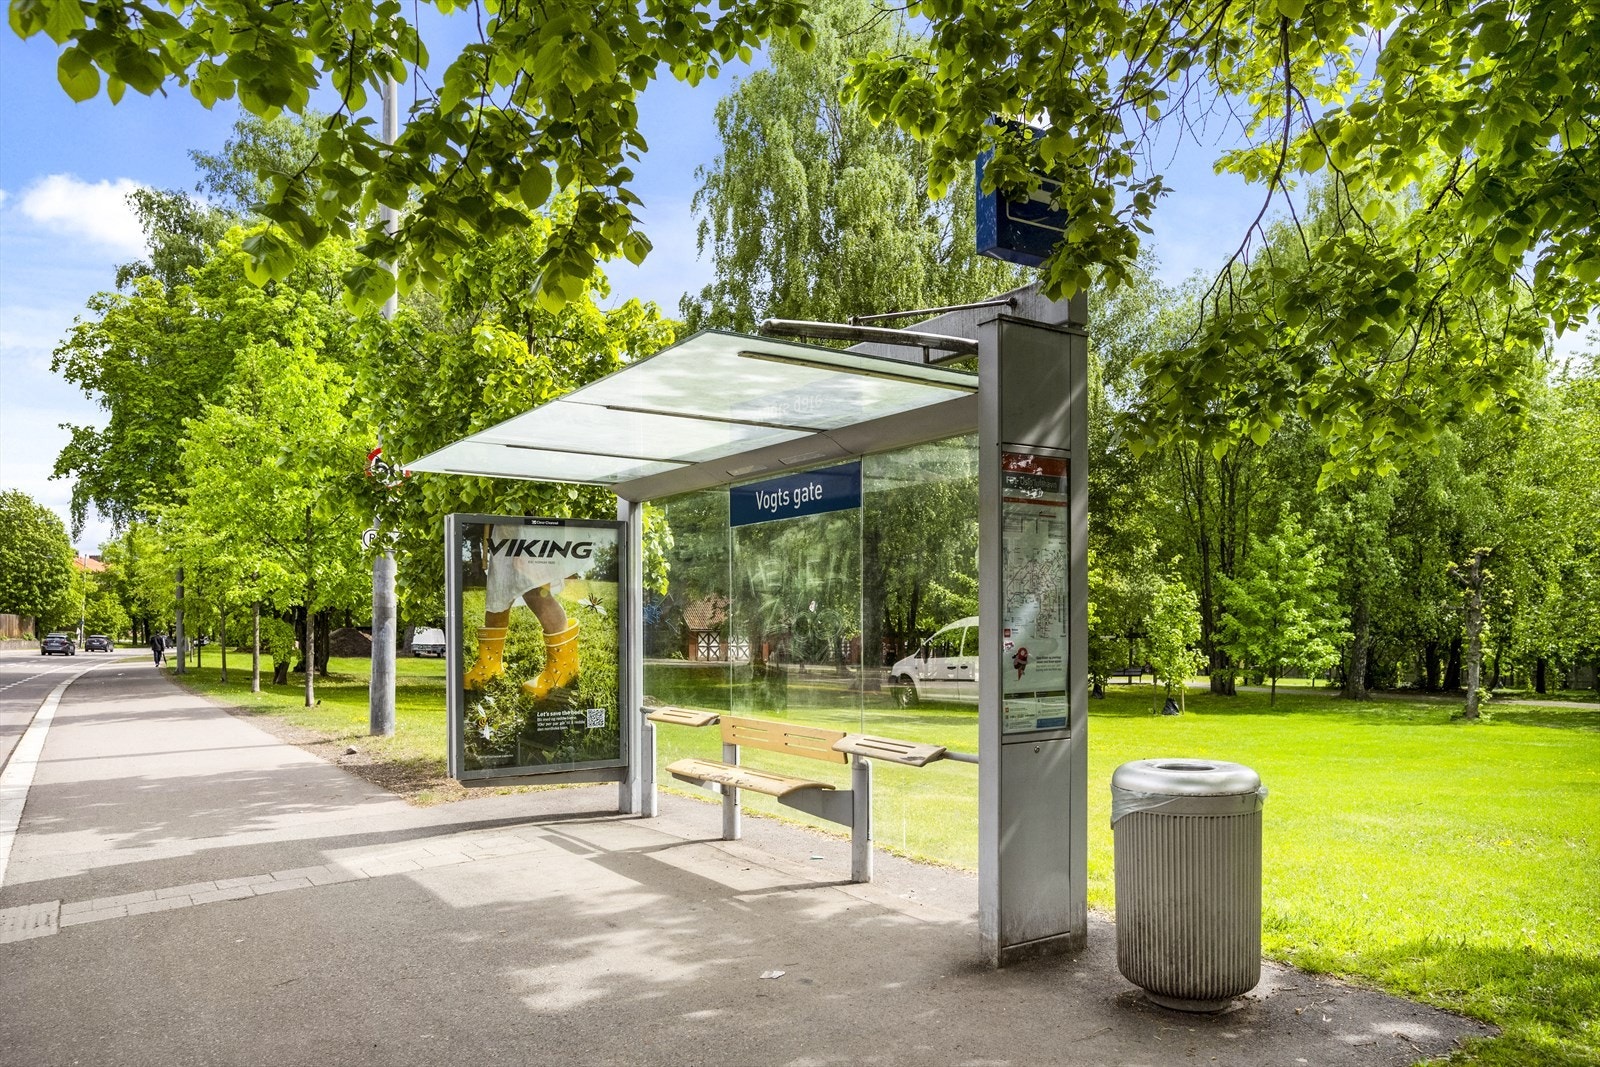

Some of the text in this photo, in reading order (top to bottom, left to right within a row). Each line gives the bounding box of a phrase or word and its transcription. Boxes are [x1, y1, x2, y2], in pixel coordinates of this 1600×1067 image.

[755, 481, 823, 513] Vogts gate
[486, 538, 593, 559] VIKING
